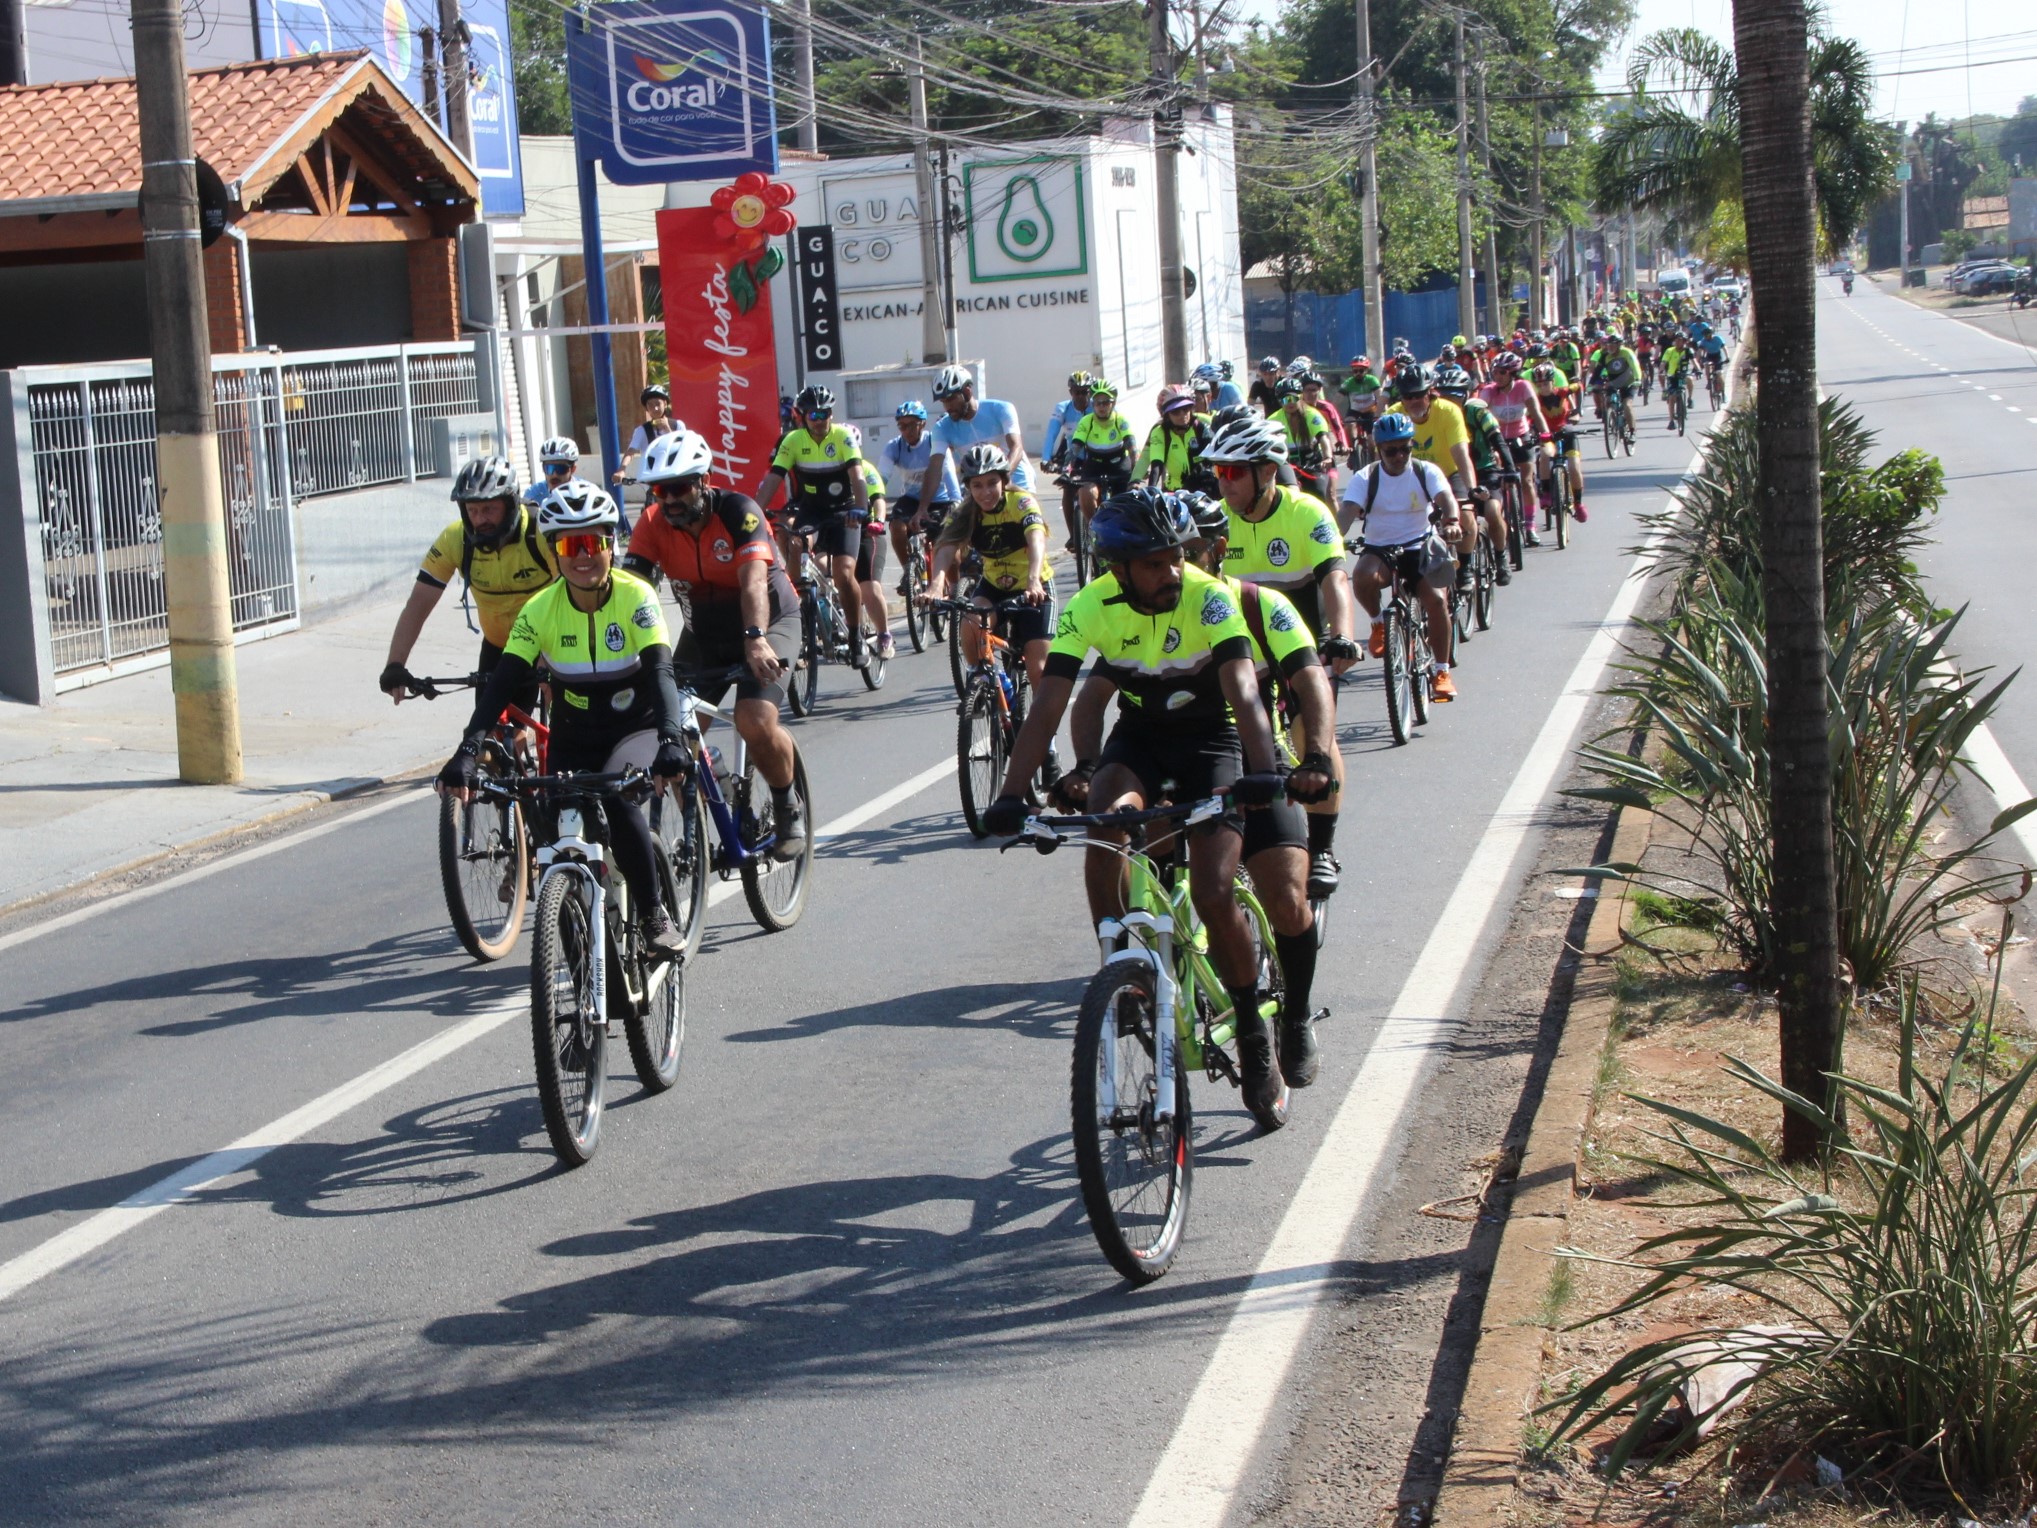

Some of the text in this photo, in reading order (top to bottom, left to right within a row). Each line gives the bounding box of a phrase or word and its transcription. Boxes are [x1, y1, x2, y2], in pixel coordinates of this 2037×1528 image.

[469, 89, 498, 121] Coral
[627, 78, 716, 112] Coral
[674, 113, 694, 123] para
[836, 197, 918, 225] GUA
[841, 238, 891, 263] CO
[1017, 289, 1088, 308] CUISINE
[701, 262, 750, 485] Happy festa
[596, 957, 605, 997] ROCKSHOX
